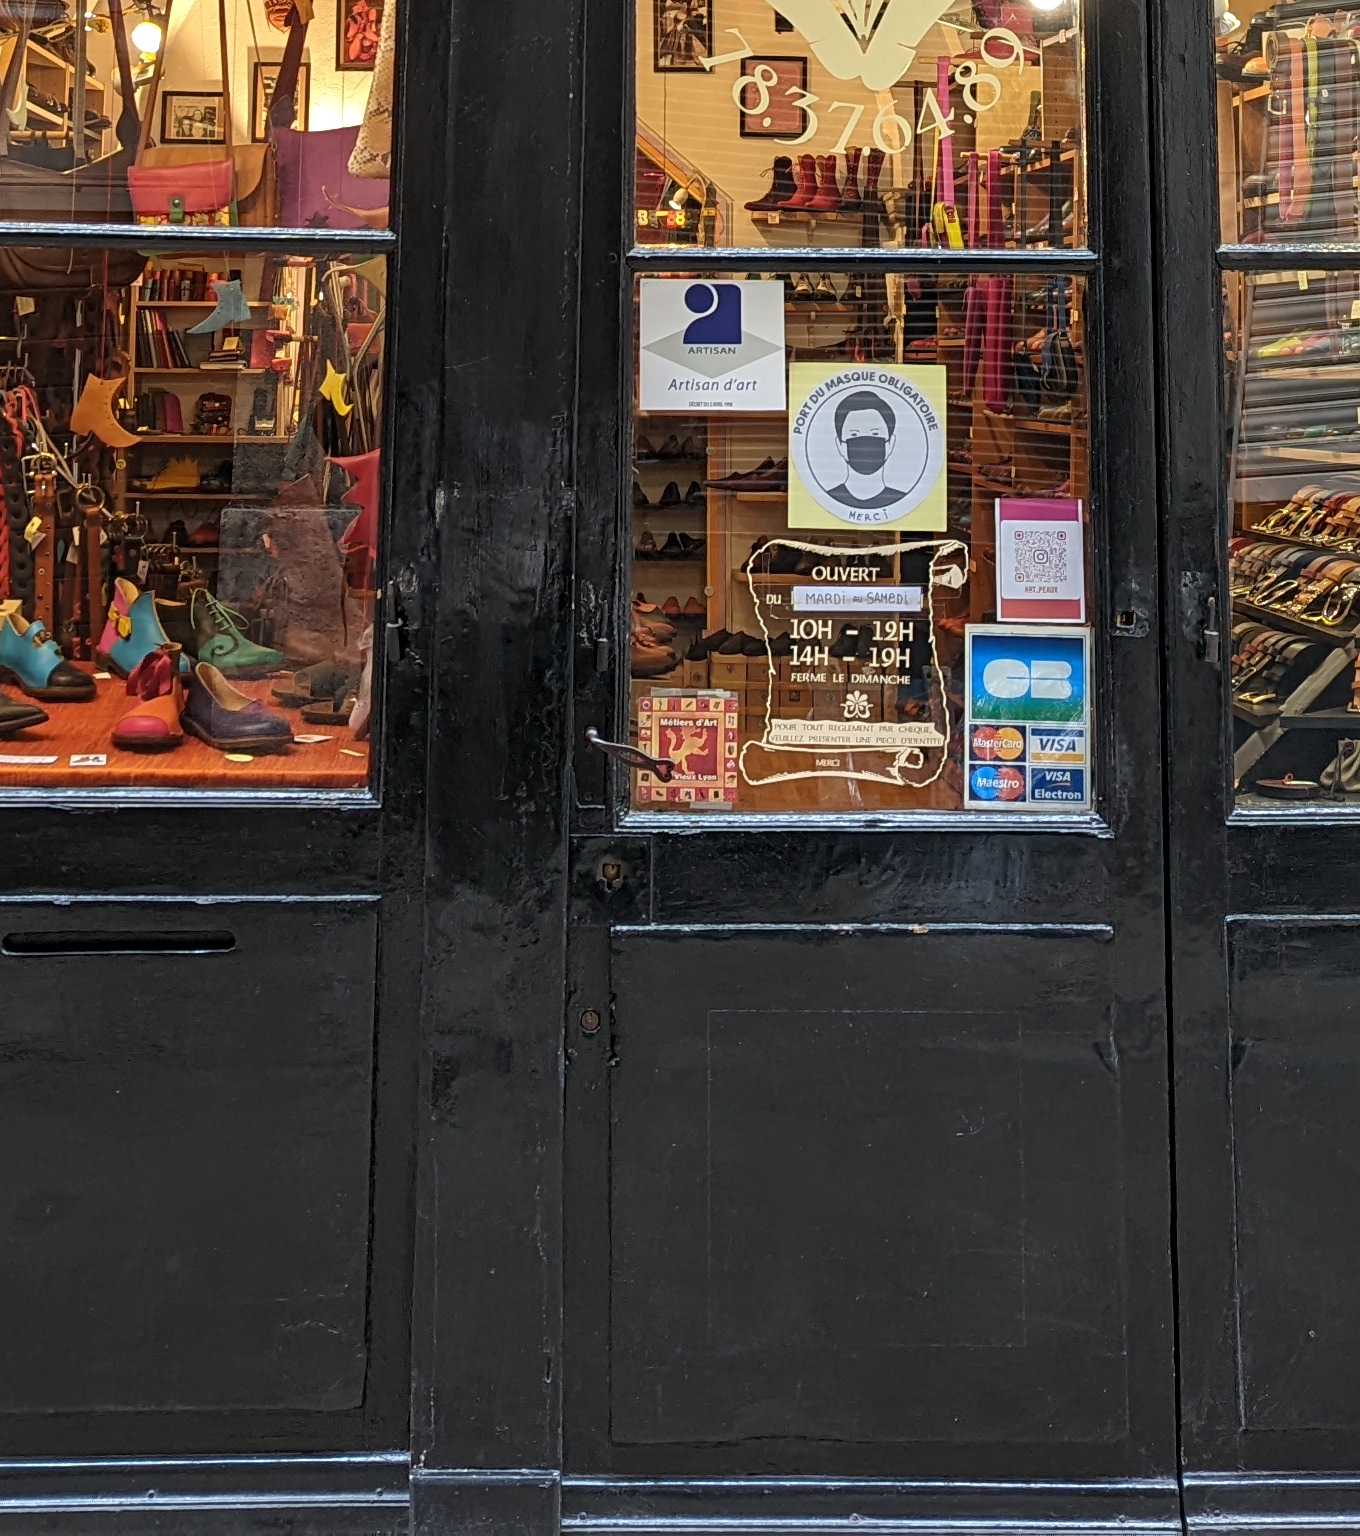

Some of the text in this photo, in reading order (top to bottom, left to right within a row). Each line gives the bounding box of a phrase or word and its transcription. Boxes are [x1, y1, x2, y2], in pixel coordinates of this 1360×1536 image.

[687, 346, 736, 355] ARTISAN
[668, 378, 758, 391] Artisan d'art
[793, 371, 939, 435] PORT DU MASQUE OBLIGATOIRE
[812, 565, 881, 582] OUVERT
[766, 593, 782, 605] DU
[790, 619, 833, 640] 10H
[872, 620, 914, 642] 12H
[790, 645, 829, 666] 14H
[869, 647, 911, 668] 19H
[790, 672, 911, 685] FERME LE DIMANCHE
[660, 717, 718, 727] Métiers d'Art
[774, 723, 797, 731] POUR
[879, 725, 893, 733] PAR
[972, 737, 1077, 752] MasterCard VISA
[815, 759, 841, 767] MERCI
[699, 773, 717, 782] Lyon
[1045, 770, 1072, 782] VISA
[976, 777, 1020, 789] Maestro
[1034, 789, 1082, 800] Electron
